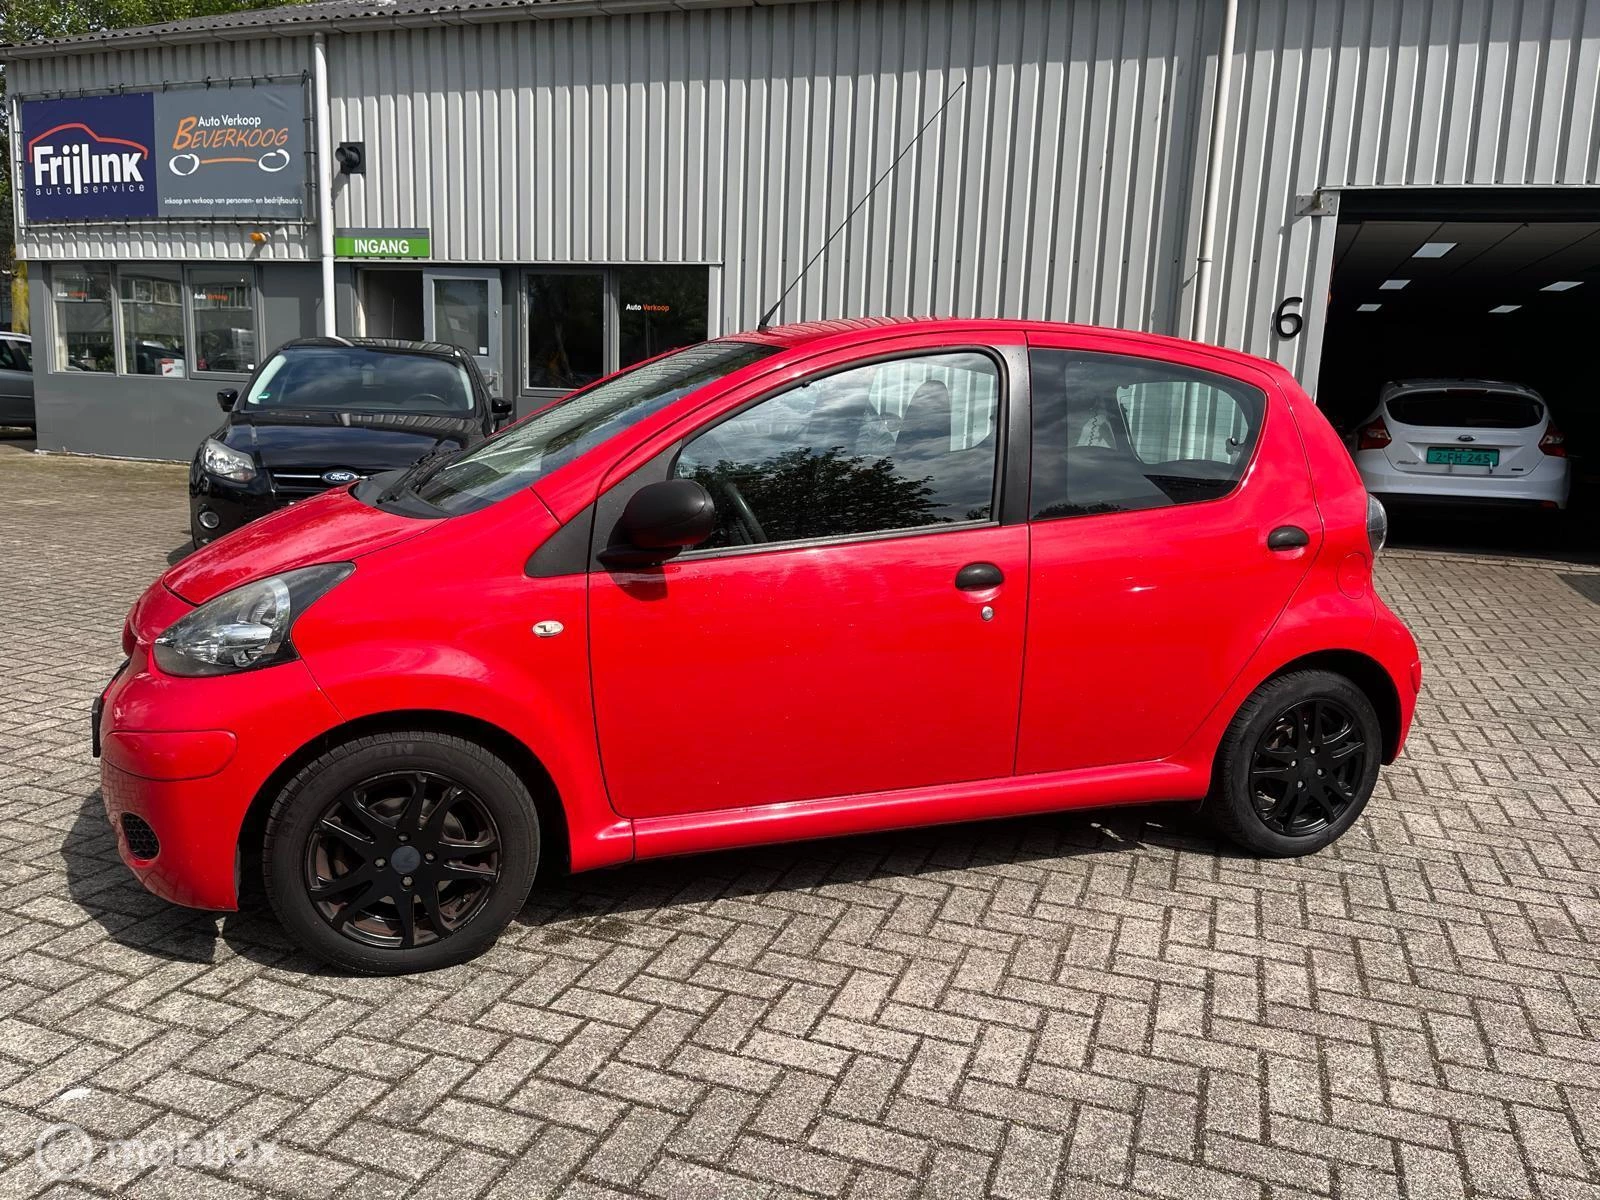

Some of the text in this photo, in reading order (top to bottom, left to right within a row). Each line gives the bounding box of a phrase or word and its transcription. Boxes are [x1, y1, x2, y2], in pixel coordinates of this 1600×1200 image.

[198, 114, 261, 128] Auto Verkoop
[172, 115, 289, 150] BEVERKOOG
[34, 144, 144, 194] Frijlink
[35, 183, 145, 196] auto service
[164, 197, 183, 206] inkoop
[191, 196, 214, 205] verkoop
[354, 239, 410, 254] INGANG
[625, 303, 670, 312] Auto Verkoop
[1276, 296, 1303, 338] 6
[330, 473, 350, 481] Ford
